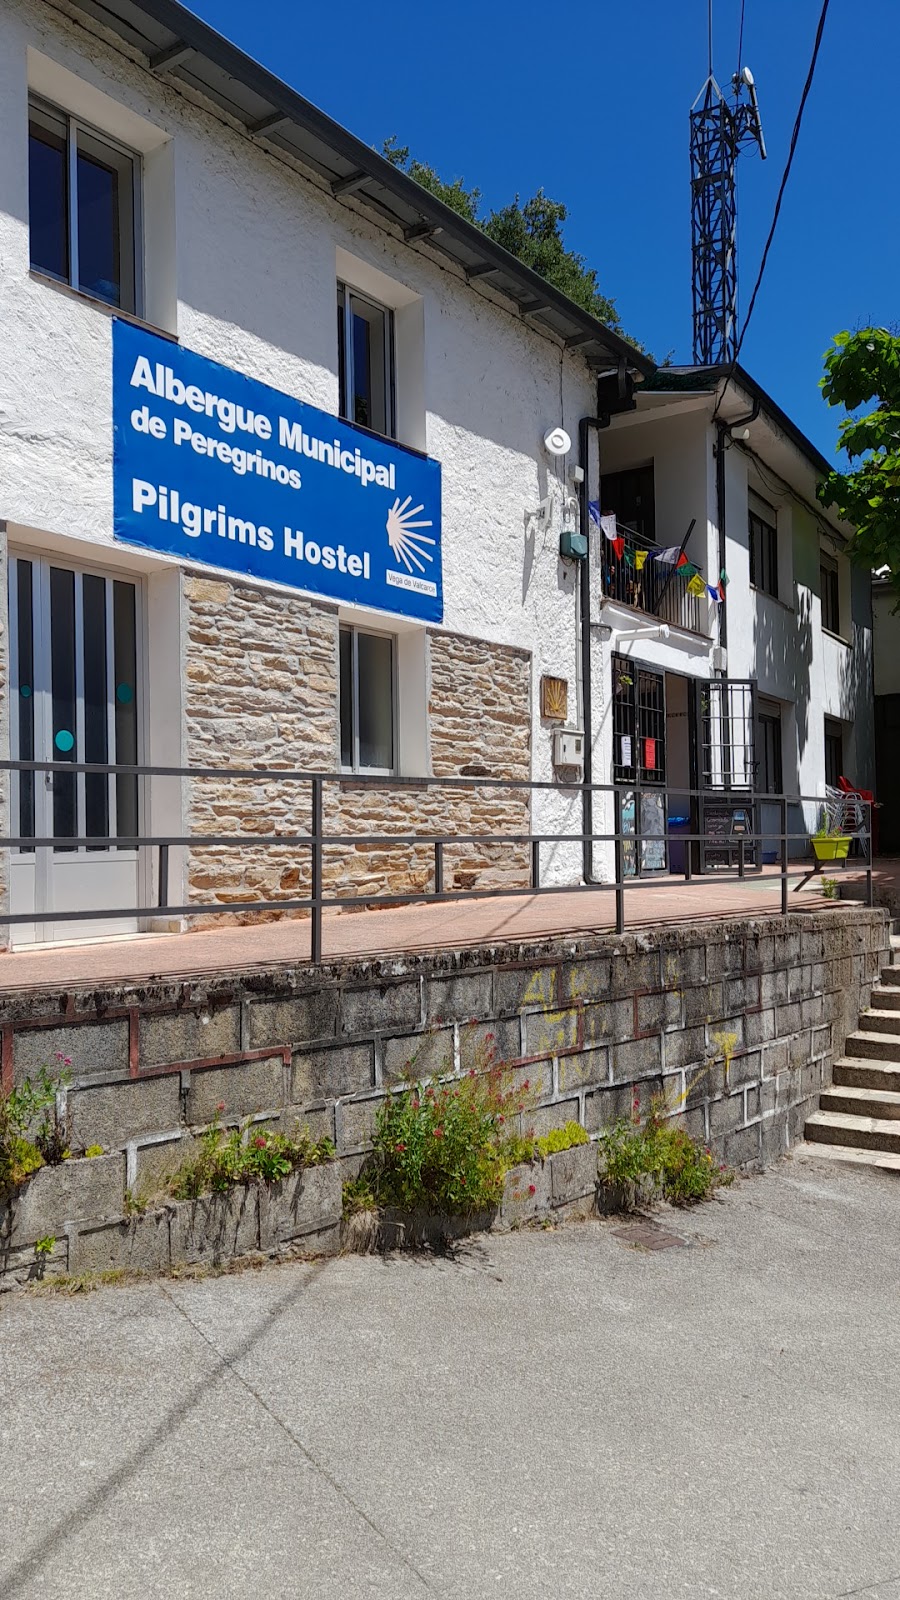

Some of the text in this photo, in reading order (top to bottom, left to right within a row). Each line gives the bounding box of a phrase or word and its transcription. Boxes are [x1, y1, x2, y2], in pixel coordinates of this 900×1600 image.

[130, 355, 396, 490] Albergue Municipal
[130, 406, 302, 489] de Peregrinos
[132, 478, 370, 579] Pilgrims Hostel
[388, 573, 436, 593] Vega de Valcarce
